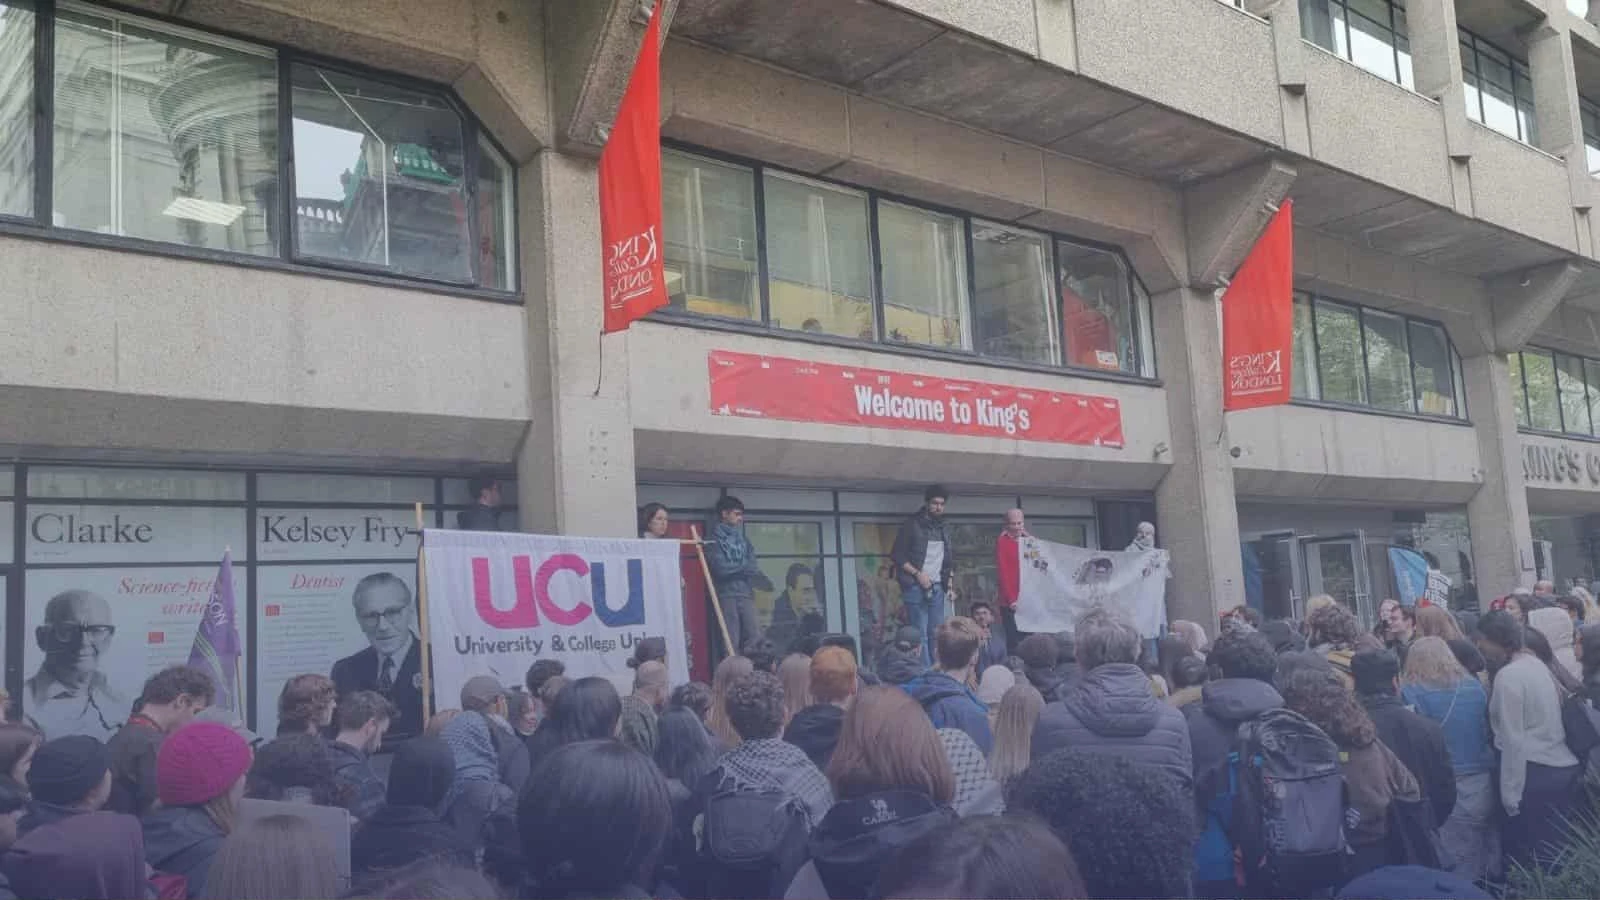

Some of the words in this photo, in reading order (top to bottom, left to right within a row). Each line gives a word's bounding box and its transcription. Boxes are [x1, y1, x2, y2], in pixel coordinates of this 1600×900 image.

[854, 384, 945, 423] Welcome
[951, 396, 971, 425] to
[976, 398, 1031, 434] King's
[31, 512, 153, 544] Clarke
[262, 516, 356, 548] Kelsey
[362, 516, 408, 547] Fry
[290, 573, 345, 590] Dentist
[454, 634, 544, 655] University
[551, 634, 566, 651] &
[568, 634, 616, 652] College
